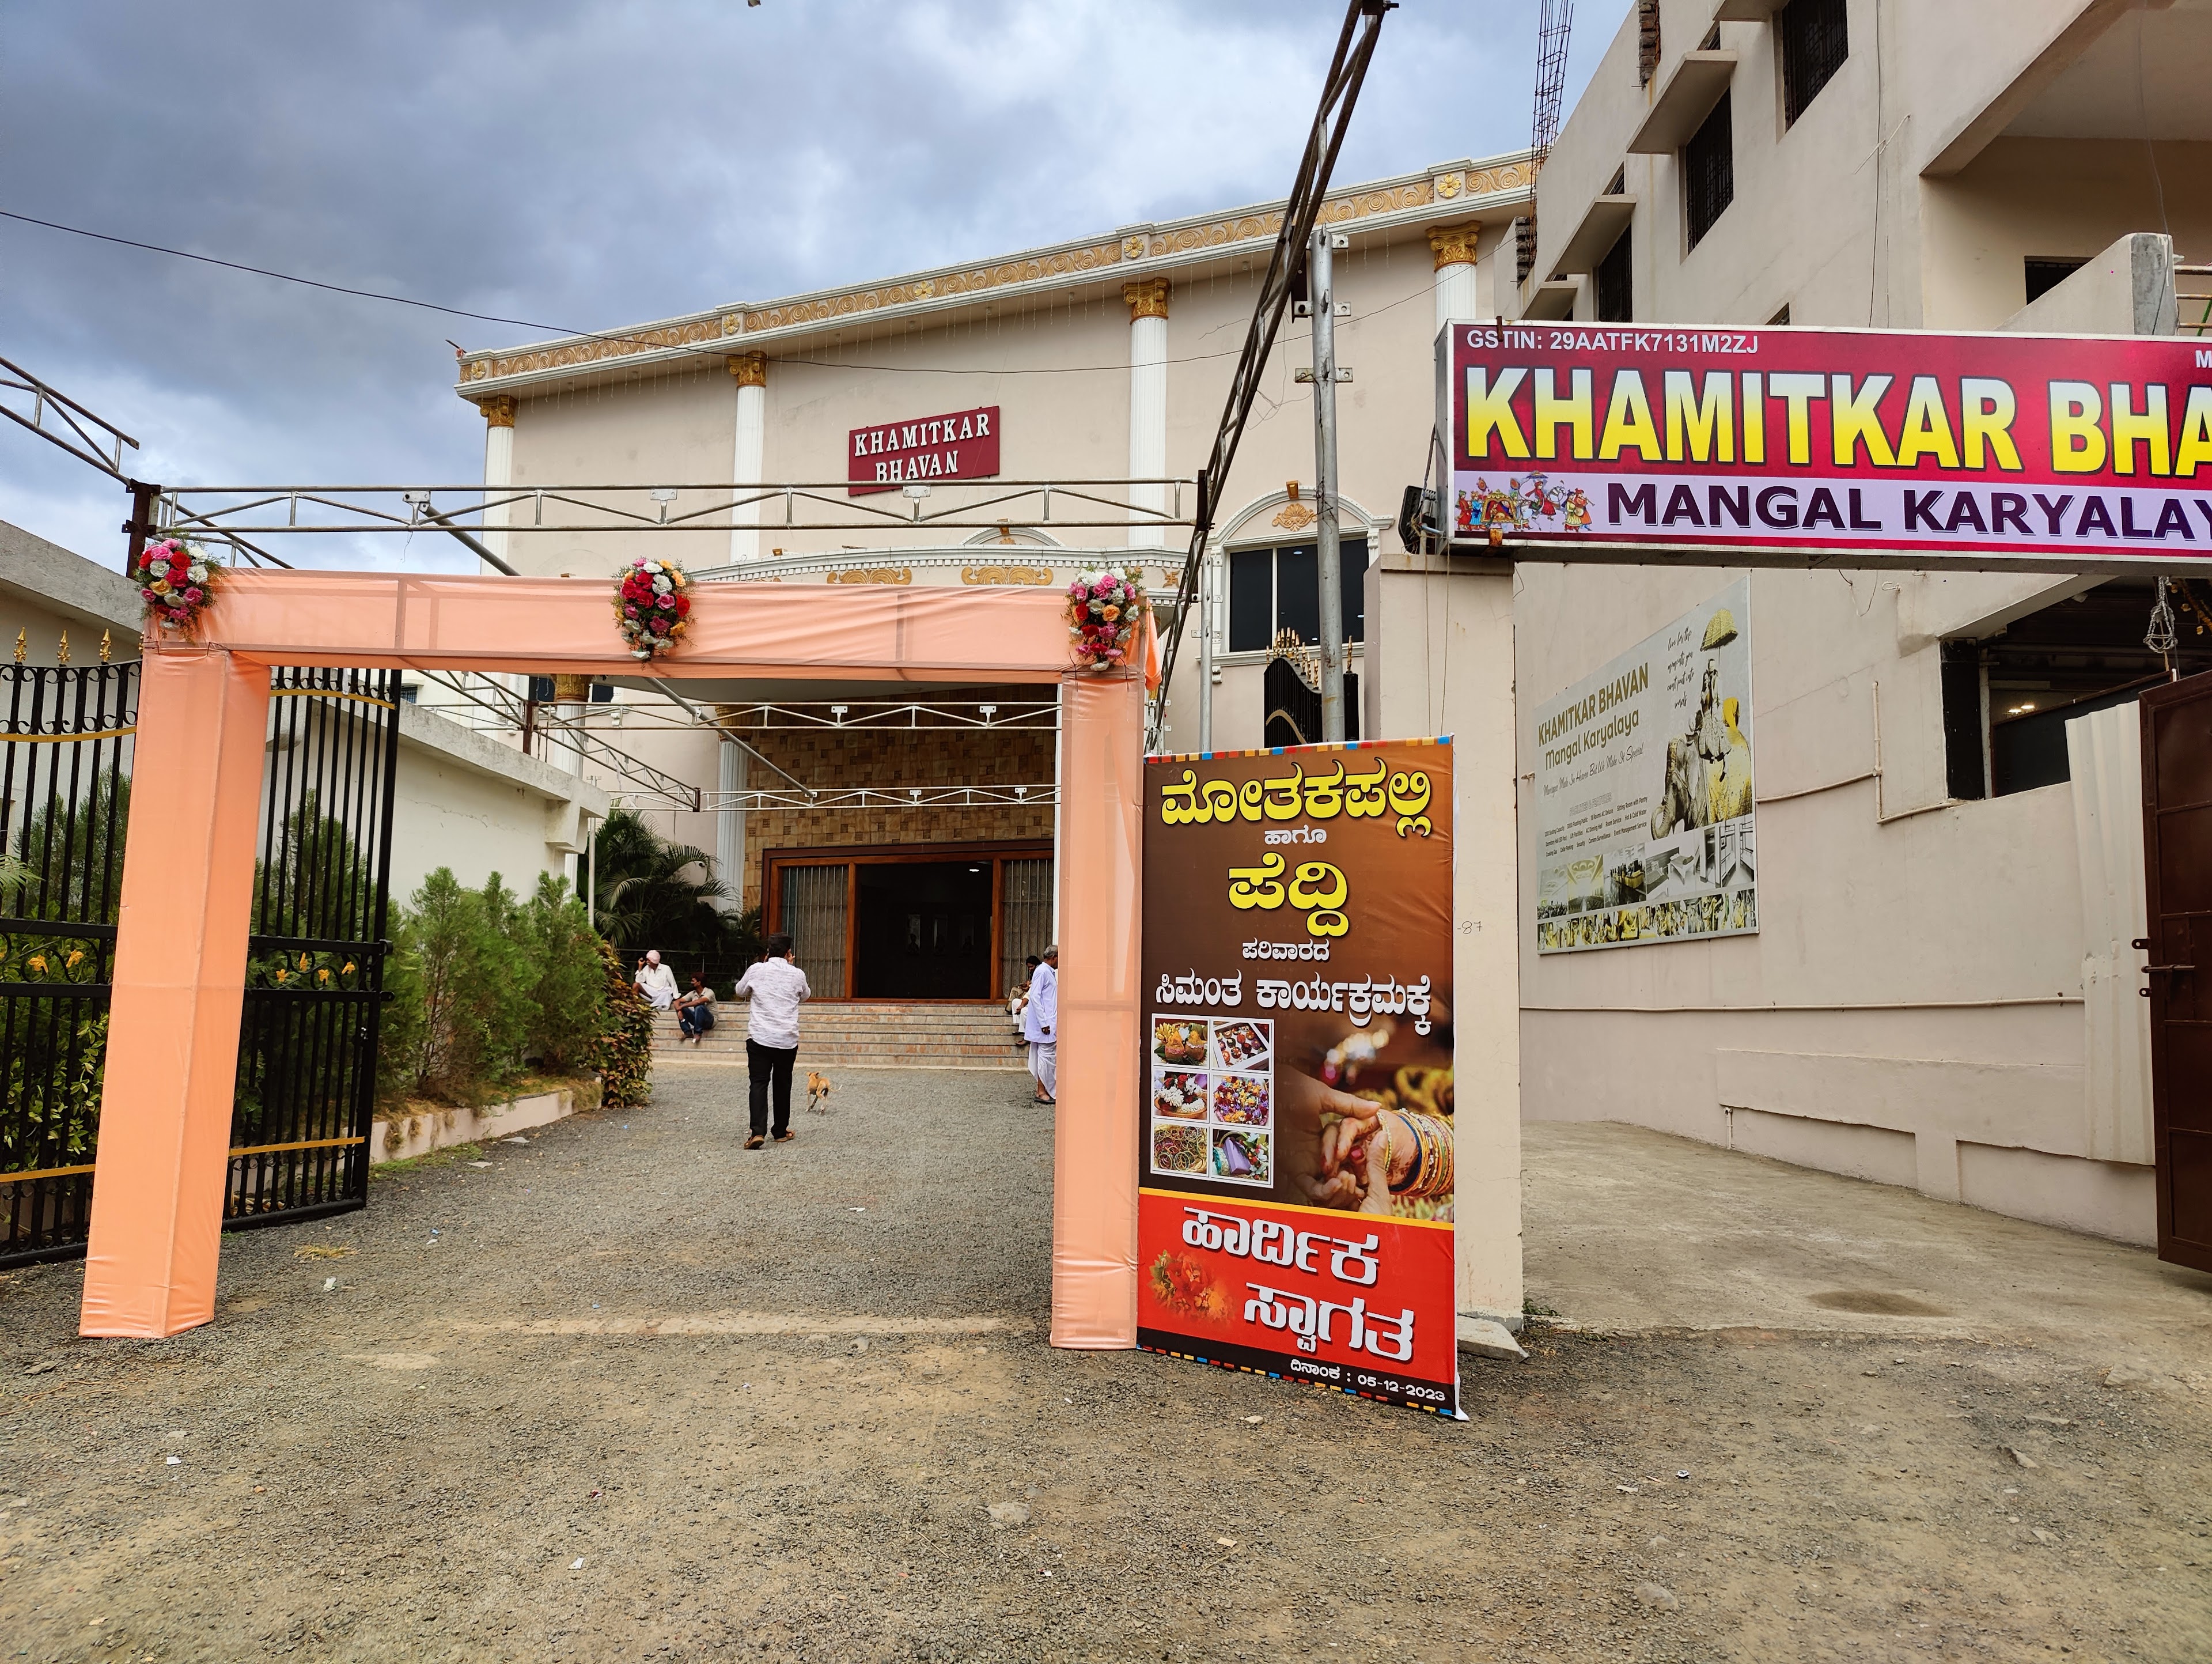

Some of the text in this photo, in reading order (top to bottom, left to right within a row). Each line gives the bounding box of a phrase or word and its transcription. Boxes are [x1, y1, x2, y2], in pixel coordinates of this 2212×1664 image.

[1467, 330, 1758, 354] GSTIN: 29AATFK7131M2ZJ
[854, 413, 990, 457] KHAMITKAR
[1466, 365, 2024, 471] KHAMITKAR
[876, 450, 959, 482] BHAVAN
[1607, 482, 1883, 530] MANGAL
[1539, 662, 1648, 747] KHAMITKAR BHAVAN
[1546, 709, 1639, 771] Mangal Karyalaya
[1626, 742, 1643, 763] Special
[1161, 757, 1431, 838] ಮೋತಕಪಲ್ಲಿ
[1264, 825, 1327, 845] ಹಾಗೂ
[1228, 852, 1349, 937] ಪೆದ್ದಿ
[1242, 938, 1330, 961] ಪರಿವಾರದ
[1156, 968, 1432, 1035] ಸಿಮಂತ ಕಾರ್ಯಕ್ರಮಕ್ಕೆ
[1181, 1207, 1380, 1285] ಹಾರ್ದಿಕ
[1244, 1282, 1415, 1362] ಸ್ವಾಗತ
[1290, 1359, 1340, 1379] ದಿನಾಂಕ
[1357, 1374, 1446, 1401] 05-12-2023
